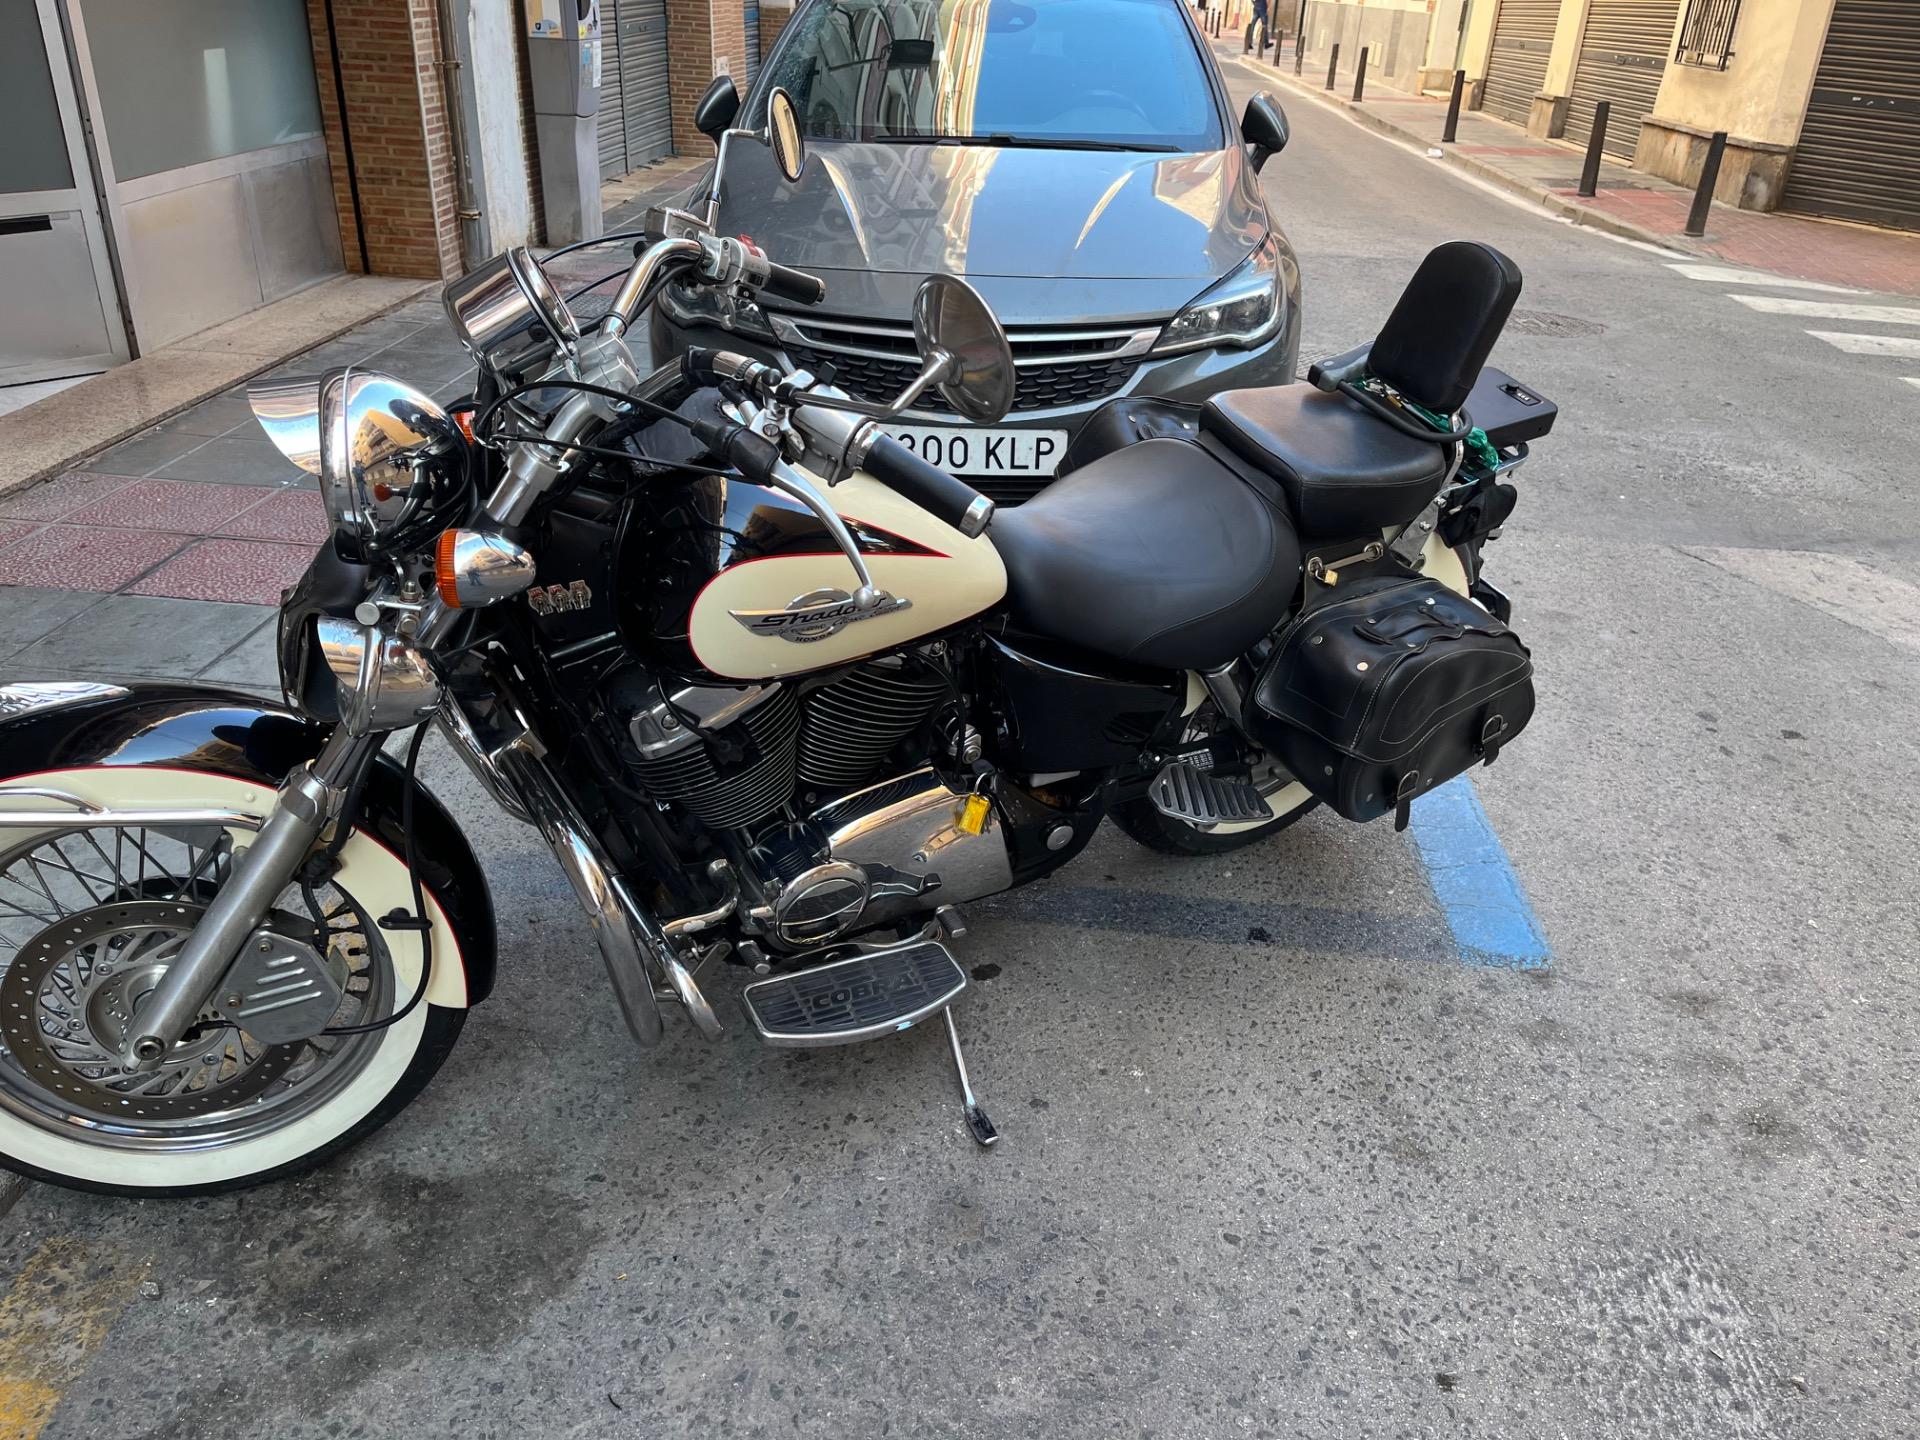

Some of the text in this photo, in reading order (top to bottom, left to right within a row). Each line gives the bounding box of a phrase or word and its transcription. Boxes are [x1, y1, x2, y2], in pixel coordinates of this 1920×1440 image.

[883, 432, 1055, 470] 300 KLP
[751, 597, 887, 628] Shado
[812, 974, 916, 1009] COBRA
